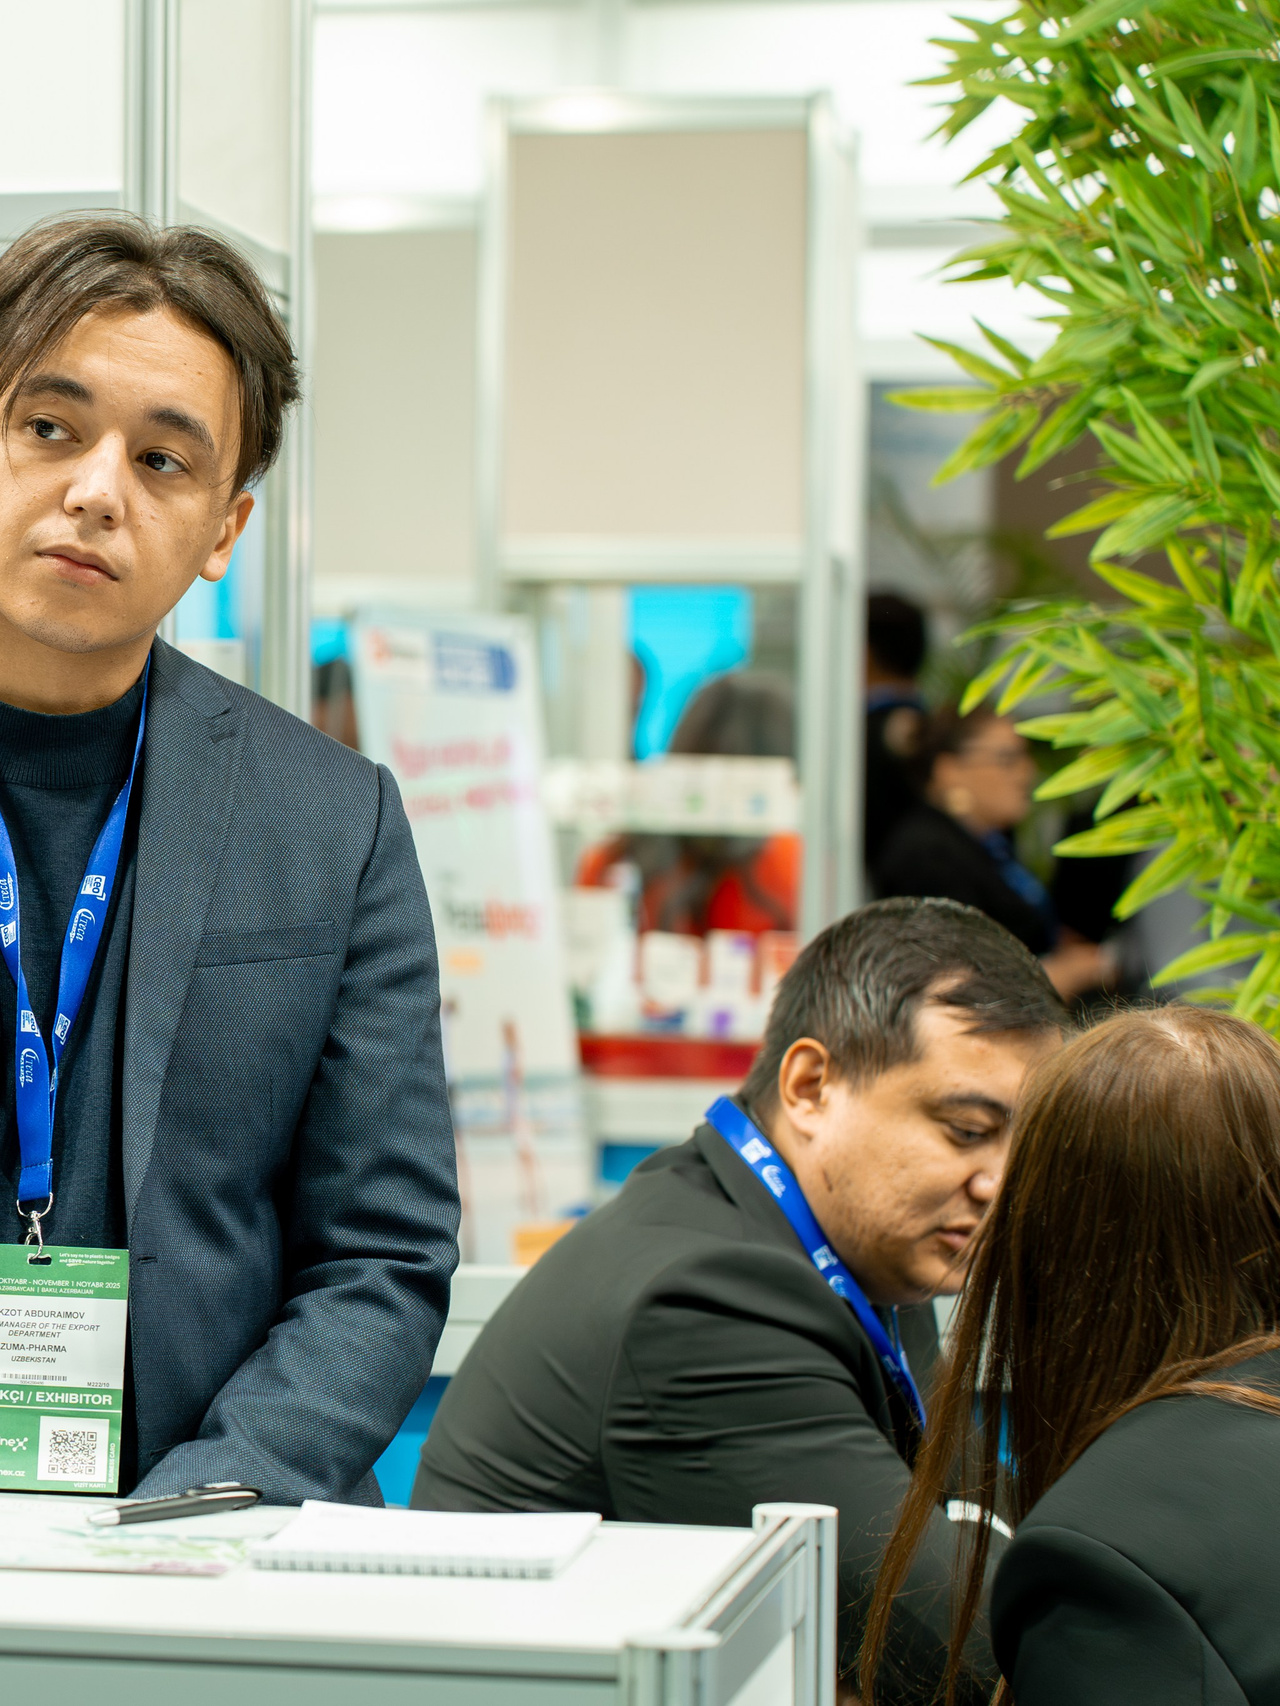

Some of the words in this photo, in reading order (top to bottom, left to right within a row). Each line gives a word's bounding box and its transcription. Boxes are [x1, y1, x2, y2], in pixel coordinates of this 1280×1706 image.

[91, 877, 102, 894] ceo
[32, 1279, 70, 1287] NOVEMBER
[24, 1309, 86, 1320] ABDURAIMOV
[68, 1324, 100, 1332] EXPORT
[8, 1330, 61, 1338] DEPARTMENT
[0, 1343, 67, 1353] ZUMA-PHARMA
[26, 1391, 33, 1404] /
[35, 1391, 113, 1405] EXHIBITOR
